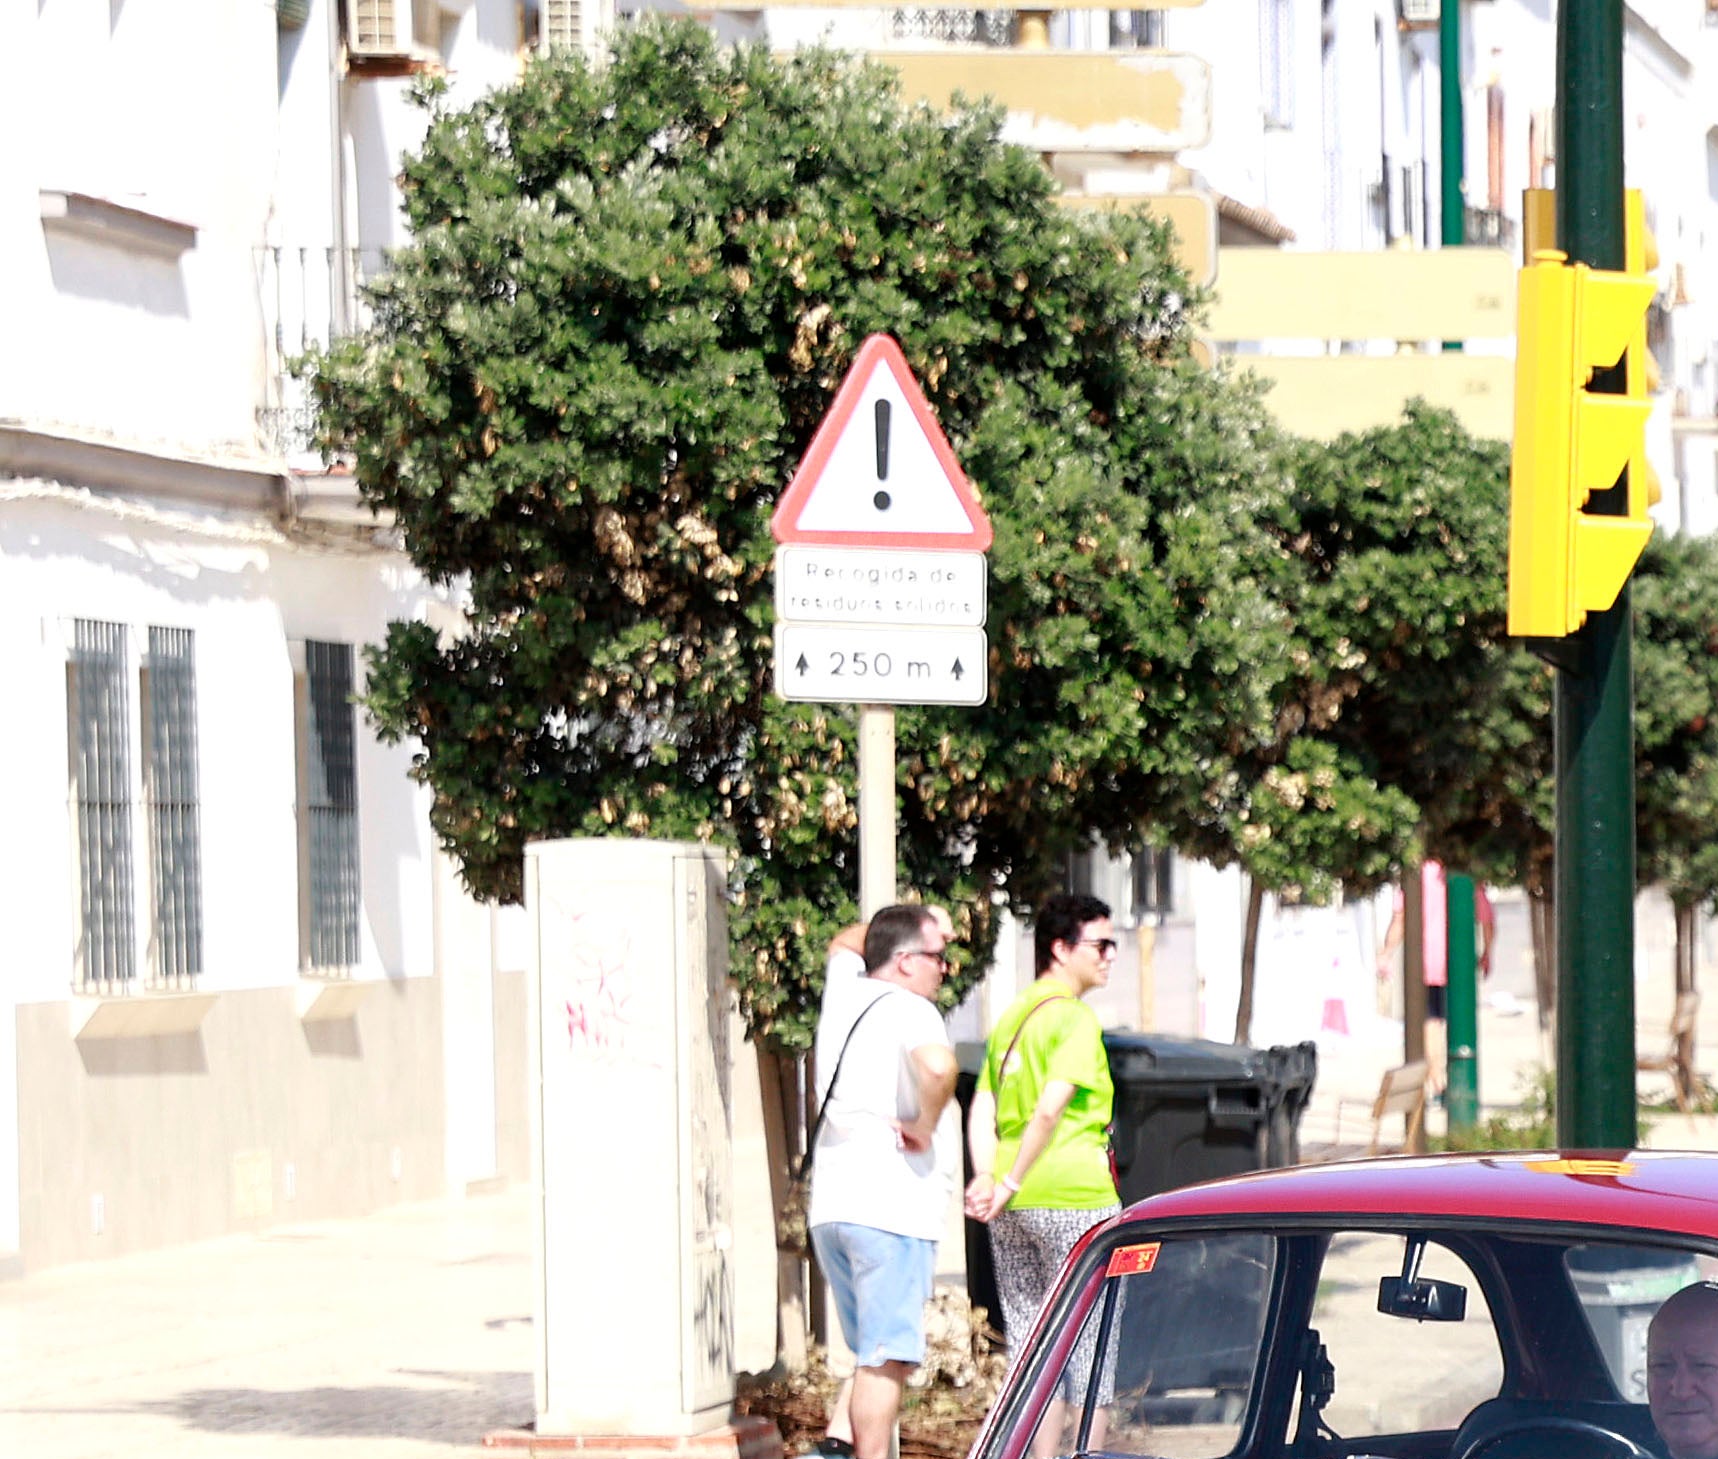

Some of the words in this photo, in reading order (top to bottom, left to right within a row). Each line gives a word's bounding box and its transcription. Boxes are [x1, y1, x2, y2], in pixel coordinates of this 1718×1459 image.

[806, 562, 918, 586] Recogida
[930, 568, 957, 584] de
[829, 651, 892, 677] 250
[907, 660, 931, 679] m
